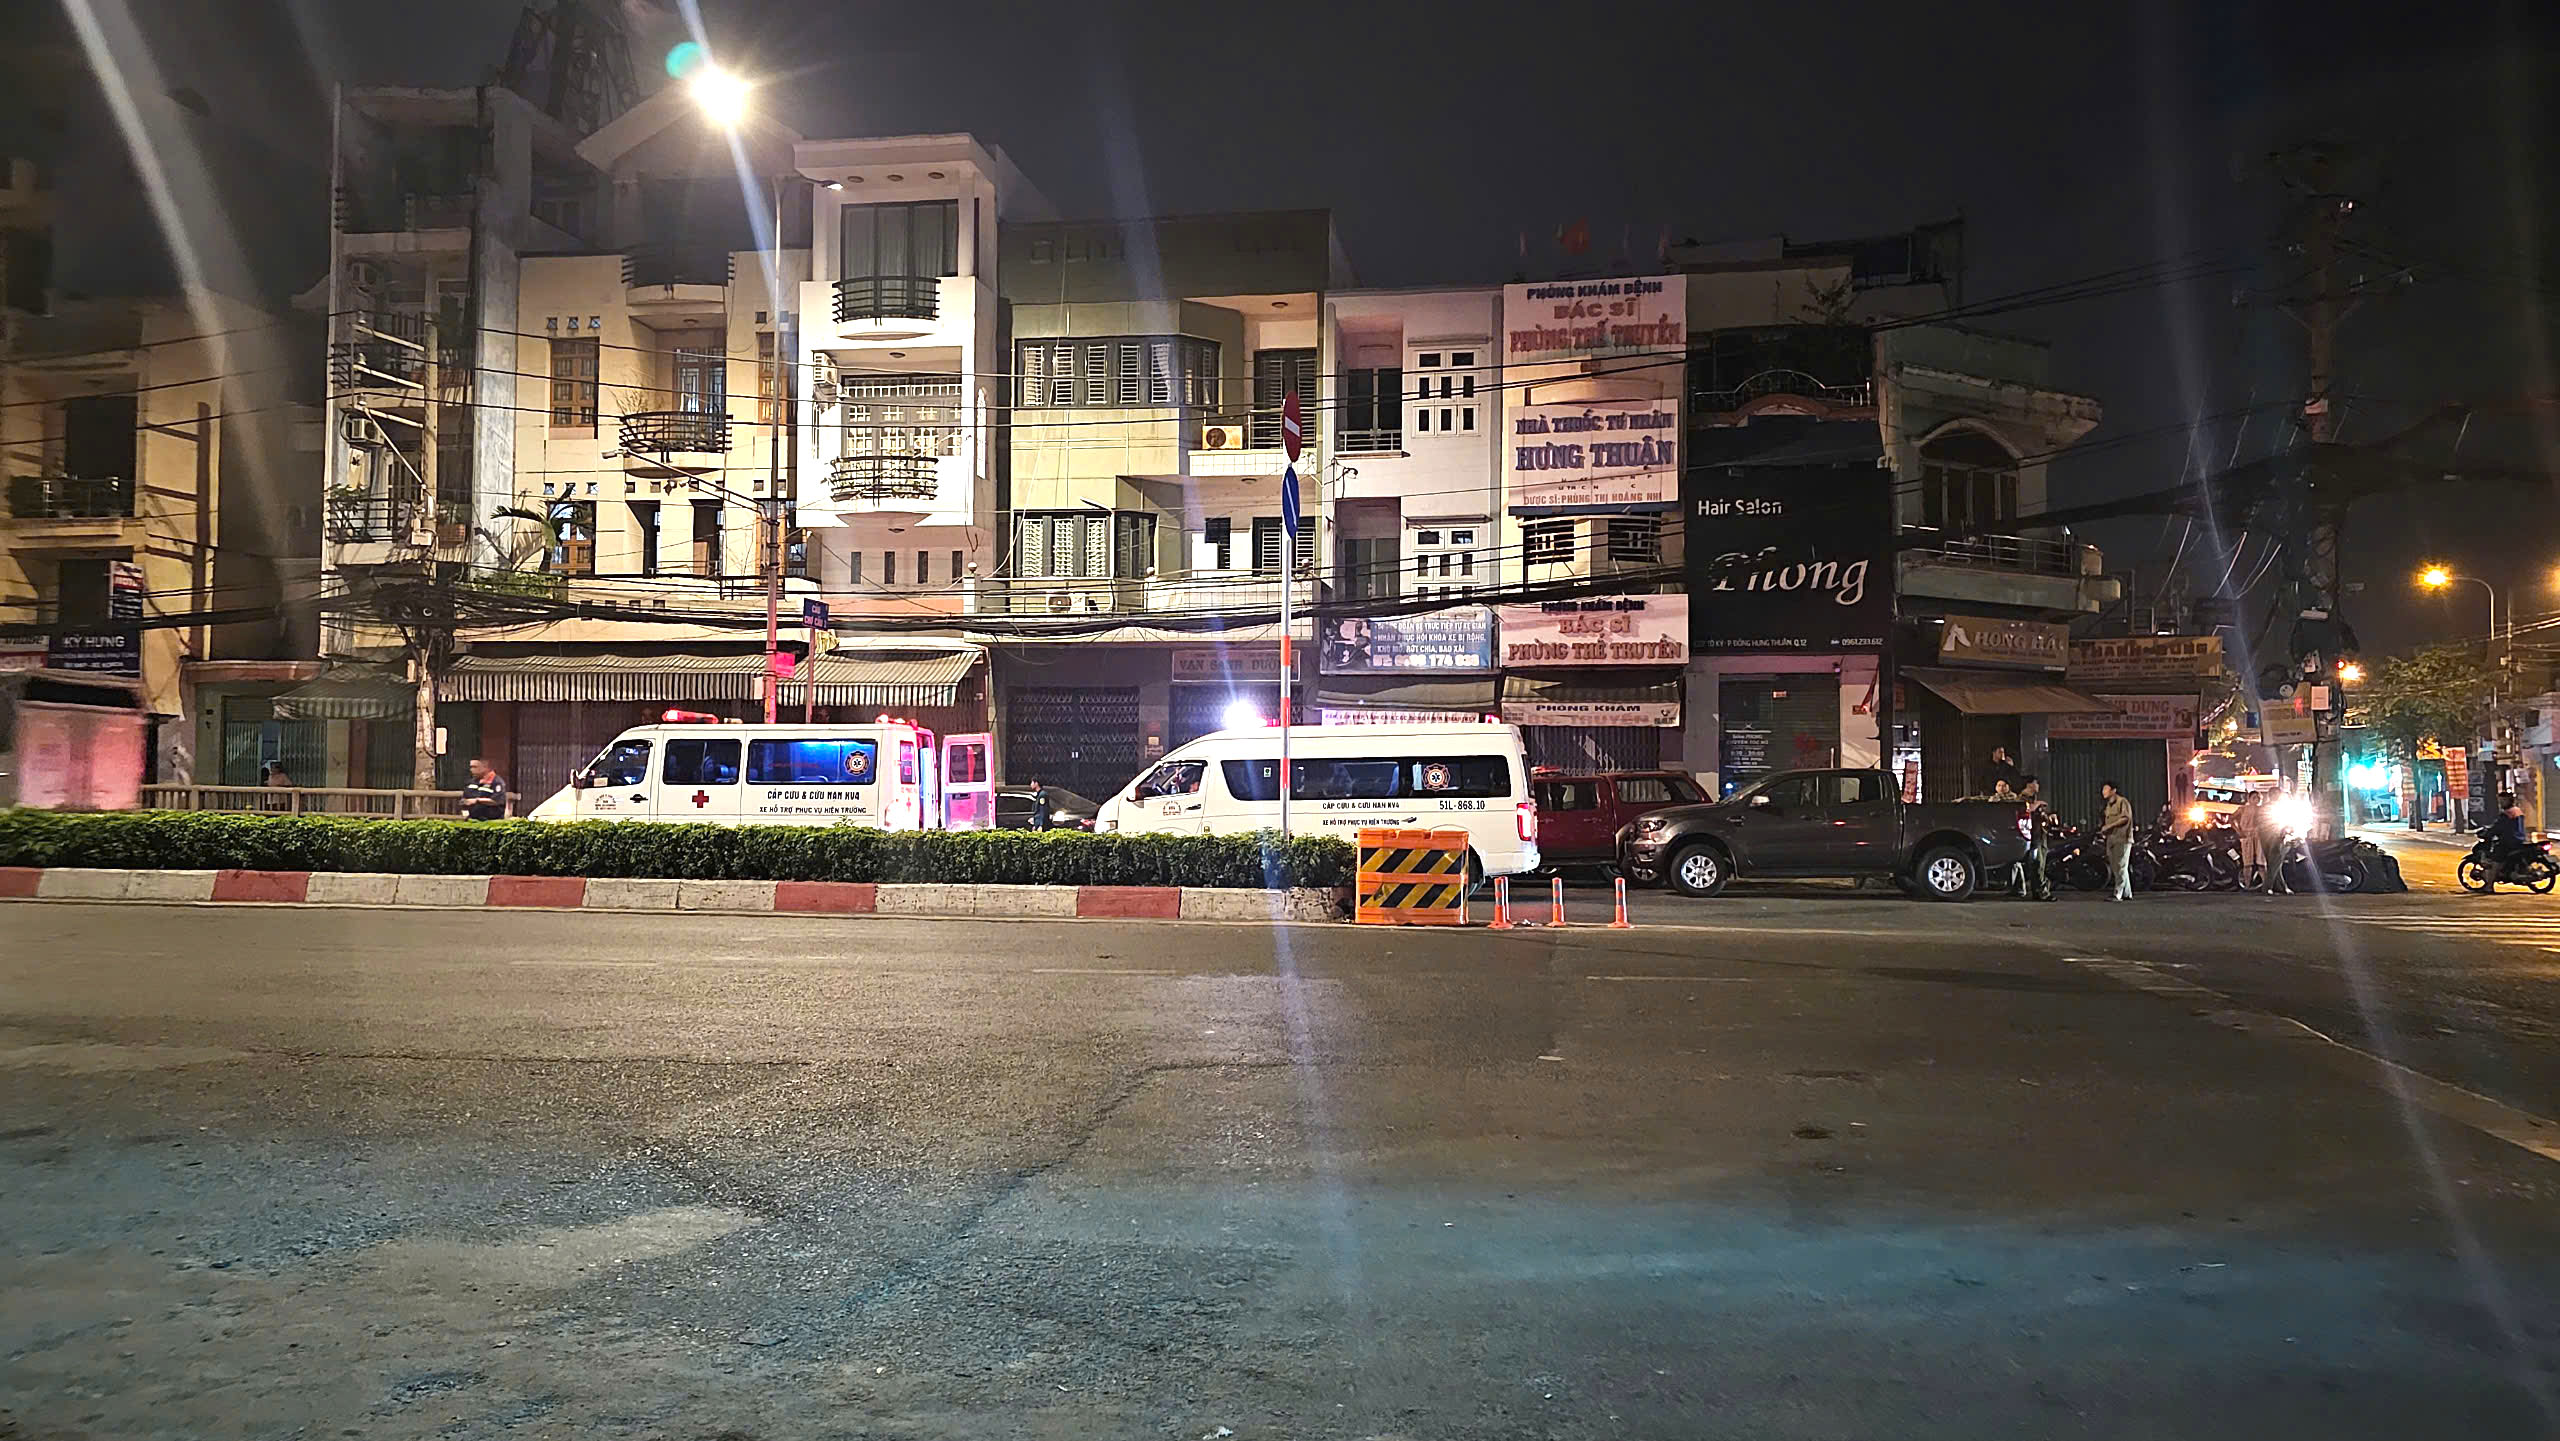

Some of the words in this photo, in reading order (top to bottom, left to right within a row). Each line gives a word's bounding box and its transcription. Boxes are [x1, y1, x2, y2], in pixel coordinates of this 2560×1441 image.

[1554, 300, 1603, 320] BÁC
[1551, 408, 1604, 433] THUỐC
[1589, 435, 1675, 471] THUẬN
[1697, 499, 1731, 516] Hair
[1735, 498, 1783, 516] Salon
[1559, 615, 1604, 634] BÁC
[801, 790, 808, 800] &
[1439, 800, 1486, 811] 51L-868.10
